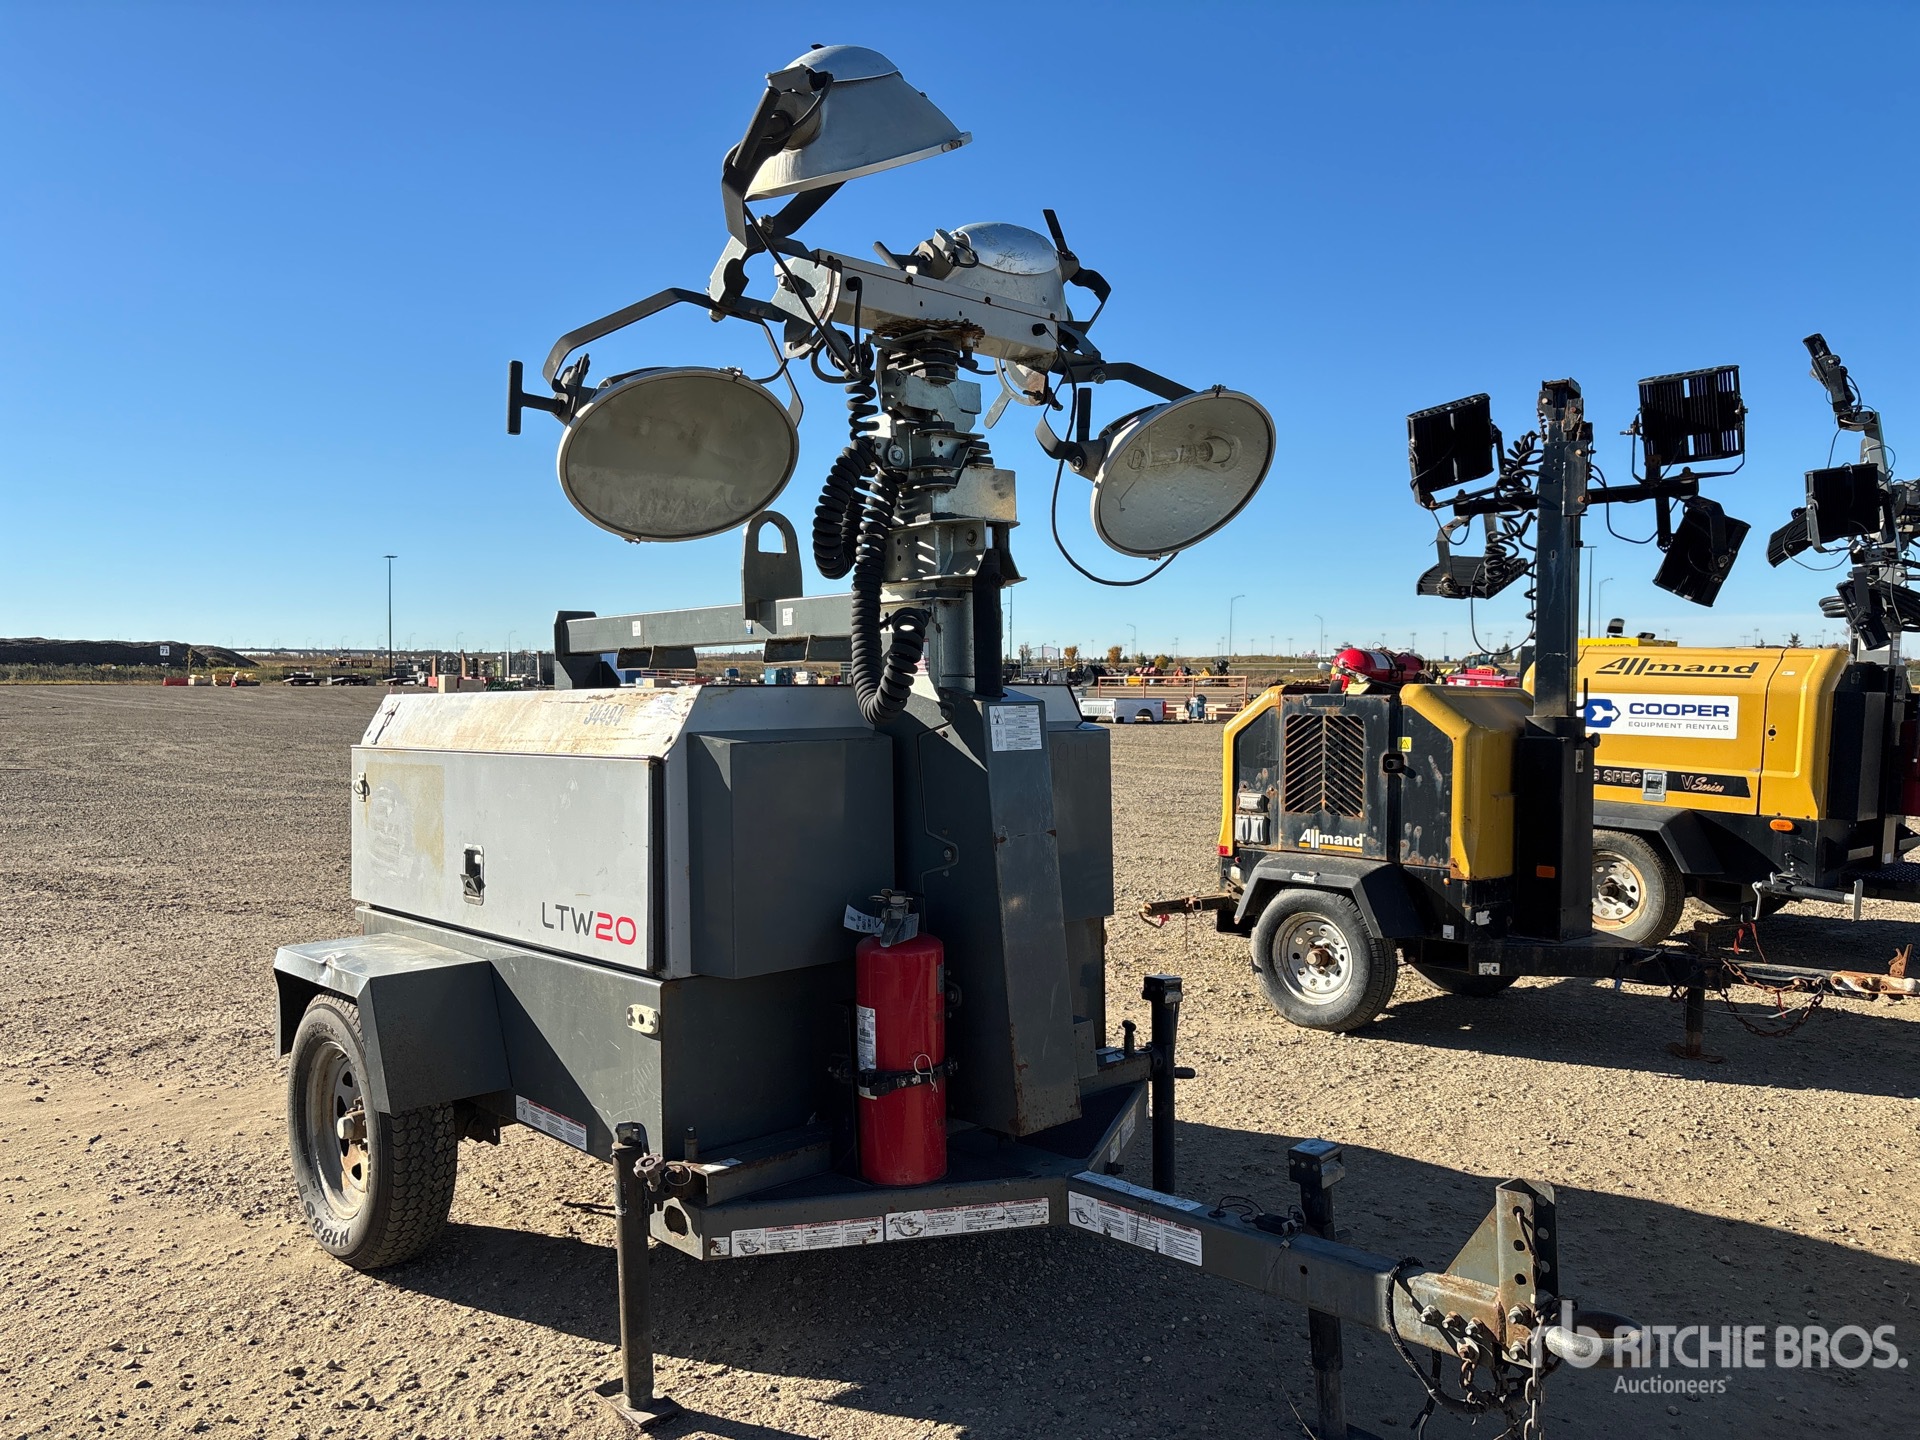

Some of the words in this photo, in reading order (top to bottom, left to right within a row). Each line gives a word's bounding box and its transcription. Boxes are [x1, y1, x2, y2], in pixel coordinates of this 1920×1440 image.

[1599, 657, 1760, 677] Allmand
[1629, 702, 1730, 717] COOPER
[1628, 721, 1682, 730] EQUIPMENT
[1685, 723, 1729, 731] RENTALS
[1603, 769, 1641, 784] SPEC
[1299, 828, 1364, 848] Allmand
[542, 901, 637, 945] LTW20
